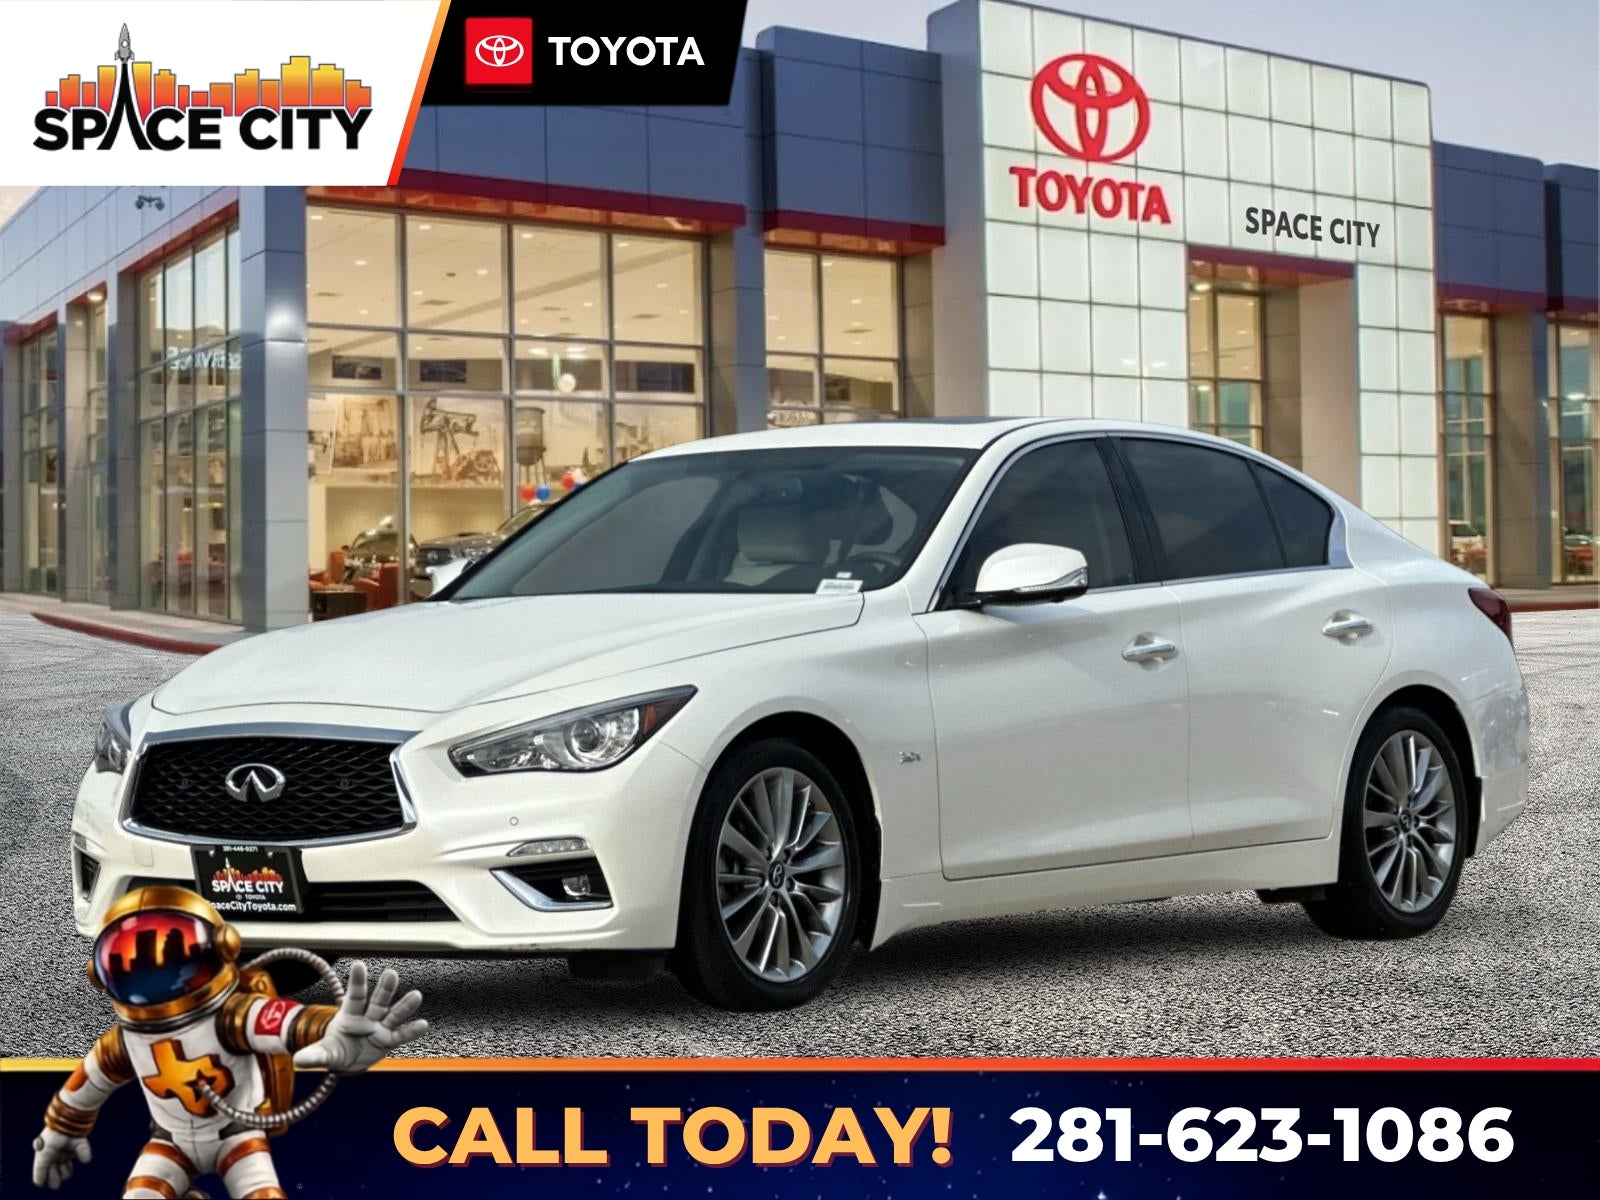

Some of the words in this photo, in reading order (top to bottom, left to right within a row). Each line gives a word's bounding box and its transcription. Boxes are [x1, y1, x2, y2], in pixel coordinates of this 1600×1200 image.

[1009, 166, 1171, 224] TOYOTA
[1245, 207, 1323, 241] SPACE
[1329, 218, 1381, 248] CITY
[212, 880, 253, 892] SPACE
[255, 880, 284, 893] CITY
[210, 901, 296, 912] paceCityToyota.com
